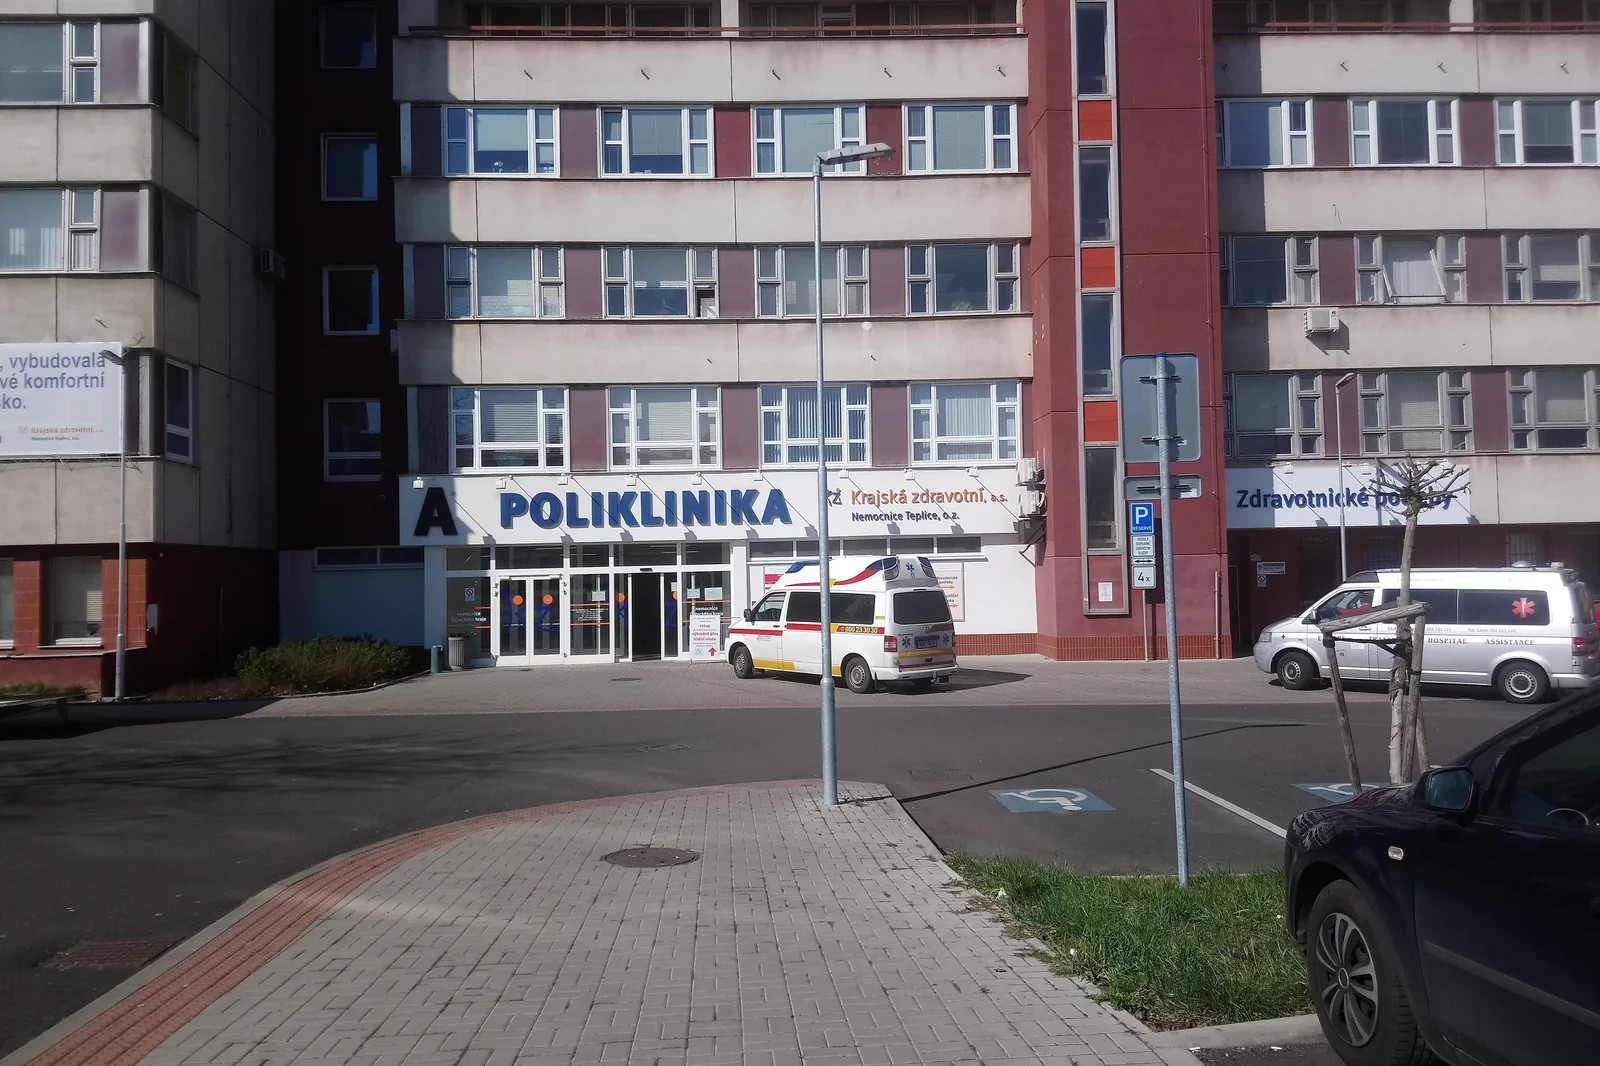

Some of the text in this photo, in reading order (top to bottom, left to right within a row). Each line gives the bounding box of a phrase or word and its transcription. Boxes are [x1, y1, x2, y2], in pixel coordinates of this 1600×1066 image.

[9, 352, 106, 372] vybudovala
[24, 371, 105, 389] komfortní
[851, 488, 1008, 508] Krajská zdravotní, a.s.
[1236, 487, 1370, 509] Zdravotnické
[414, 487, 458, 536] A
[500, 489, 792, 530] POLIKLINIKA
[851, 511, 961, 523] Nemocnice Teplice, o.z.
[1135, 506, 1149, 525] P
[1427, 637, 1468, 645] HOSPITAL
